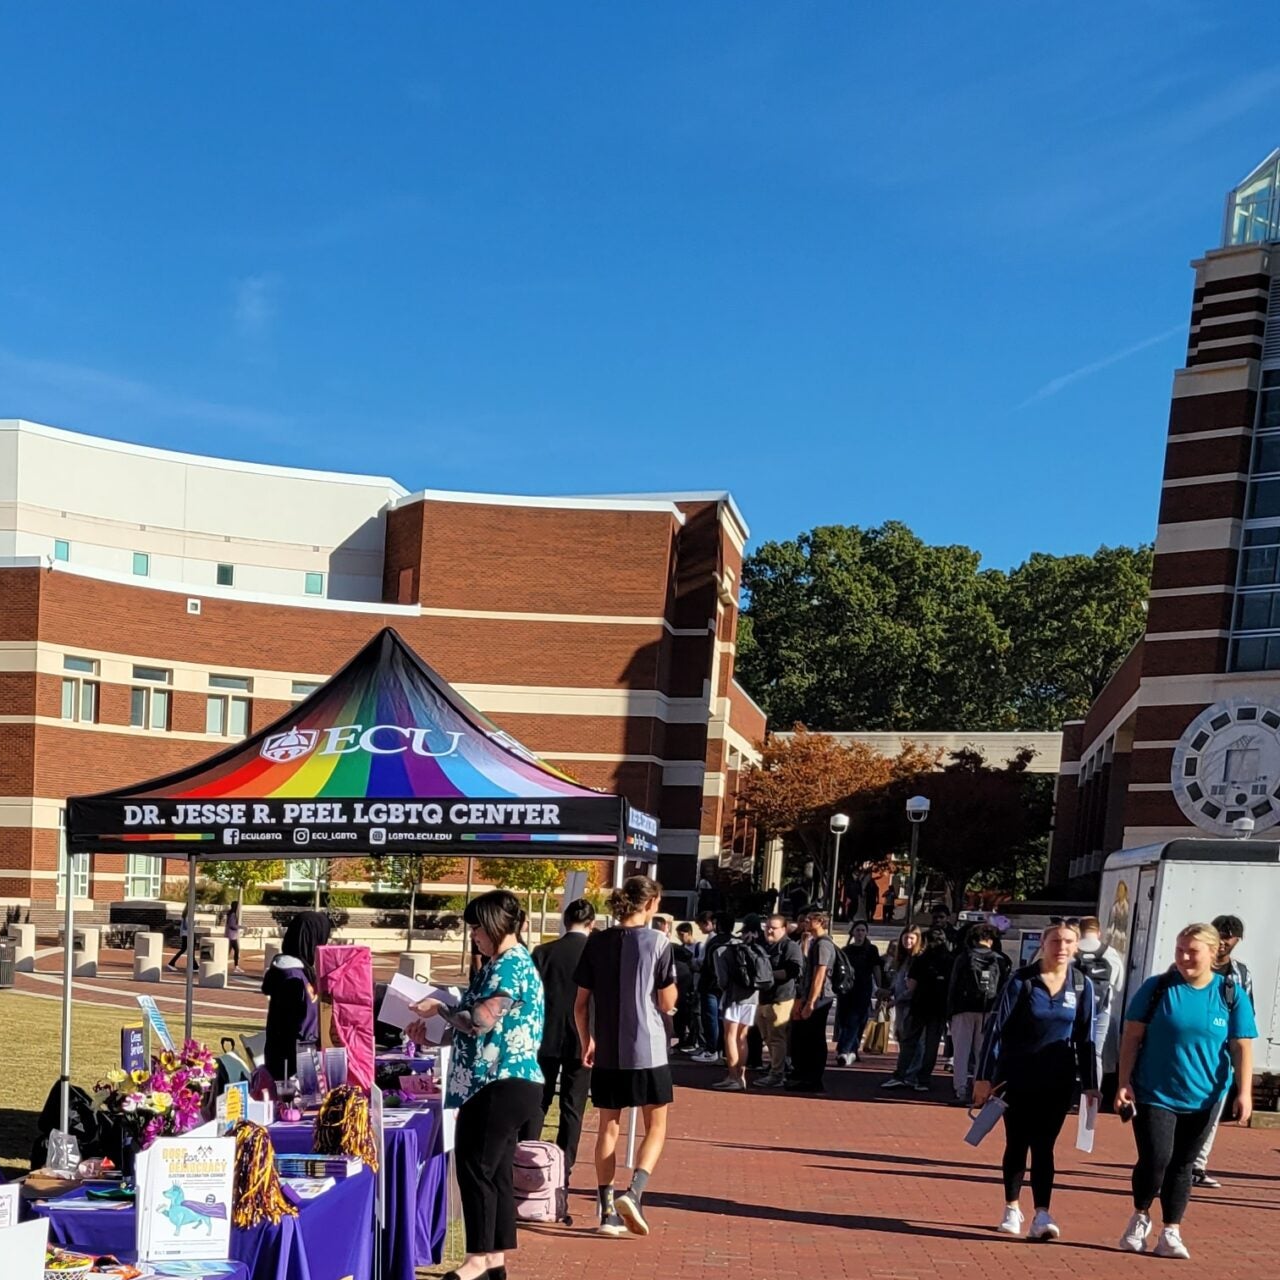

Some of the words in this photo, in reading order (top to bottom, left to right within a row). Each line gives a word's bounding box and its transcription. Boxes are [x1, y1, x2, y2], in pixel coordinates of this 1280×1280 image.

[323, 725, 463, 757] ECU
[124, 805, 165, 825] DR.
[172, 804, 246, 824] JESSE
[252, 804, 276, 824] R.
[283, 803, 347, 823] PEEL
[353, 803, 443, 824] LGBTQ
[449, 804, 560, 825] CENTER
[312, 832, 357, 840] ECU_LGBTQ
